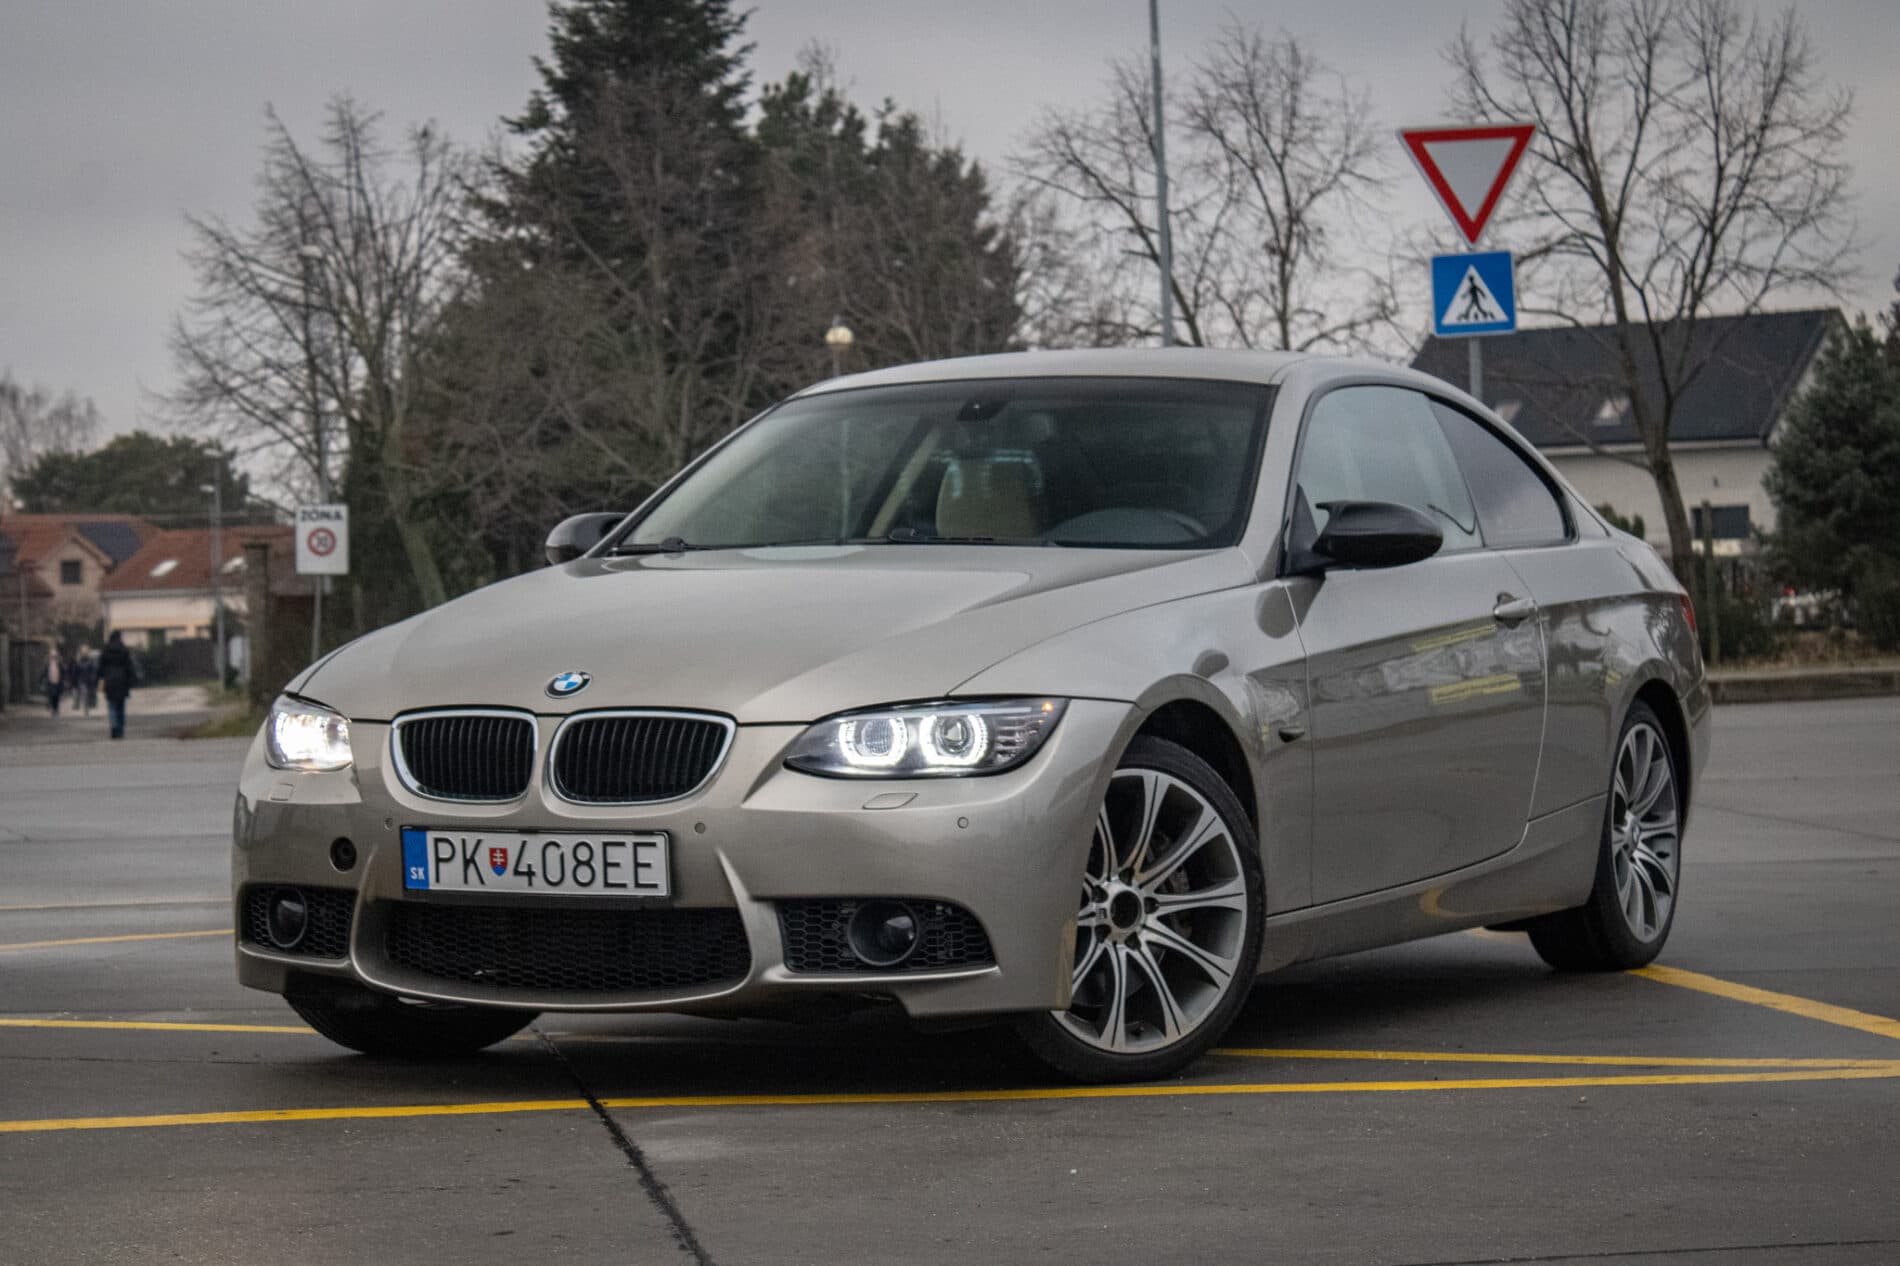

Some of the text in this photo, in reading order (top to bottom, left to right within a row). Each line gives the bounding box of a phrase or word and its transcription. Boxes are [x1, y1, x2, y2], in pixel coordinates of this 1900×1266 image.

[410, 866, 426, 881] SK
[433, 837, 659, 889] PK 408EE
